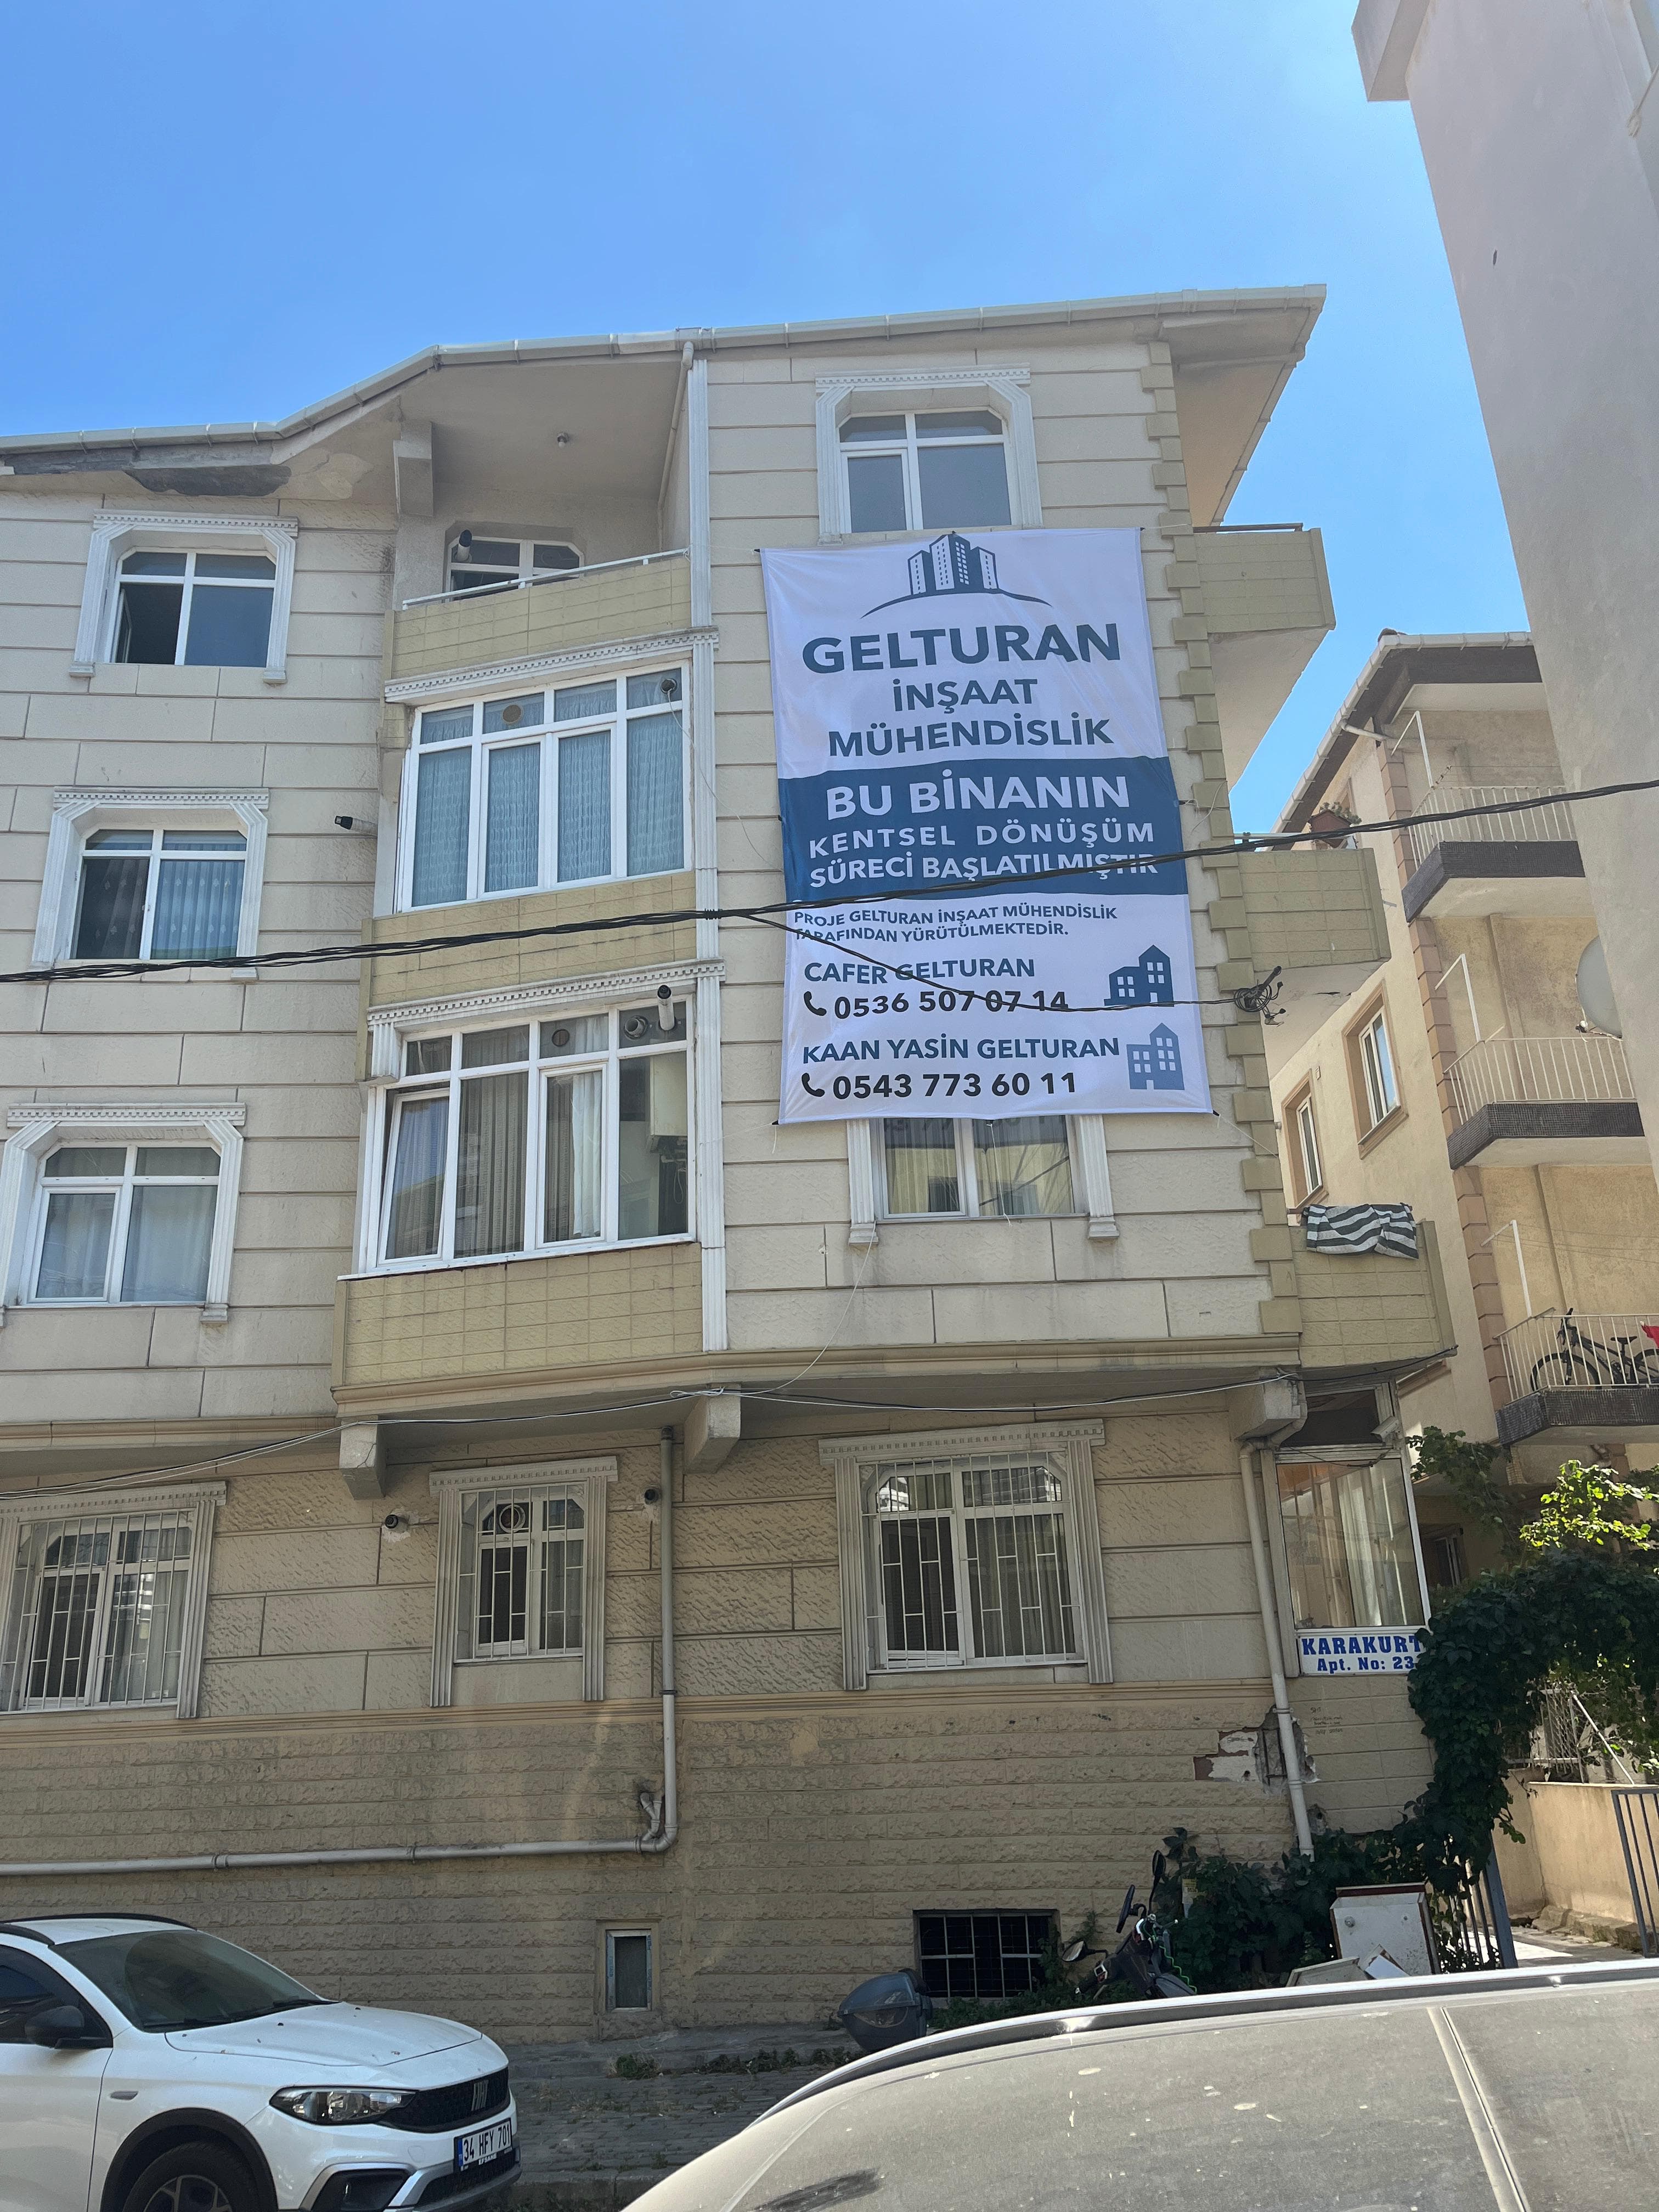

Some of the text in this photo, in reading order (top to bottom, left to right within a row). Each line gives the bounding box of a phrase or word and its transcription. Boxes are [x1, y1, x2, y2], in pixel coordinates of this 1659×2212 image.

[802, 623, 1120, 673] GELTURAN
[893, 679, 1038, 714] İNŞAAT
[829, 712, 1113, 757] MÜHENDİSLİK
[826, 769, 1130, 821] BU BİNANIN
[810, 817, 1154, 859] KENTSEL DÖNÜŞÜM
[810, 851, 913, 888] SÜRECİ
[794, 902, 1118, 927] PROJE GELTURAN İNŞAAT MÜHENDİSLİK
[901, 921, 1068, 942] YÜRÜTÜLMEKTEDİR.
[804, 958, 1035, 984] CAFER GELTURAN
[834, 990, 1069, 1019] 0536 507 07 14
[804, 1032, 1120, 1065] KAAN YASİN GELTURAN
[833, 1072, 1075, 1099] 0543 773 60 11
[1301, 1635, 1421, 1655] KARAKURT
[1317, 1656, 1414, 1674] Apt. No: 23
[464, 2137, 475, 2162] 34
[479, 2131, 494, 2157] HFY
